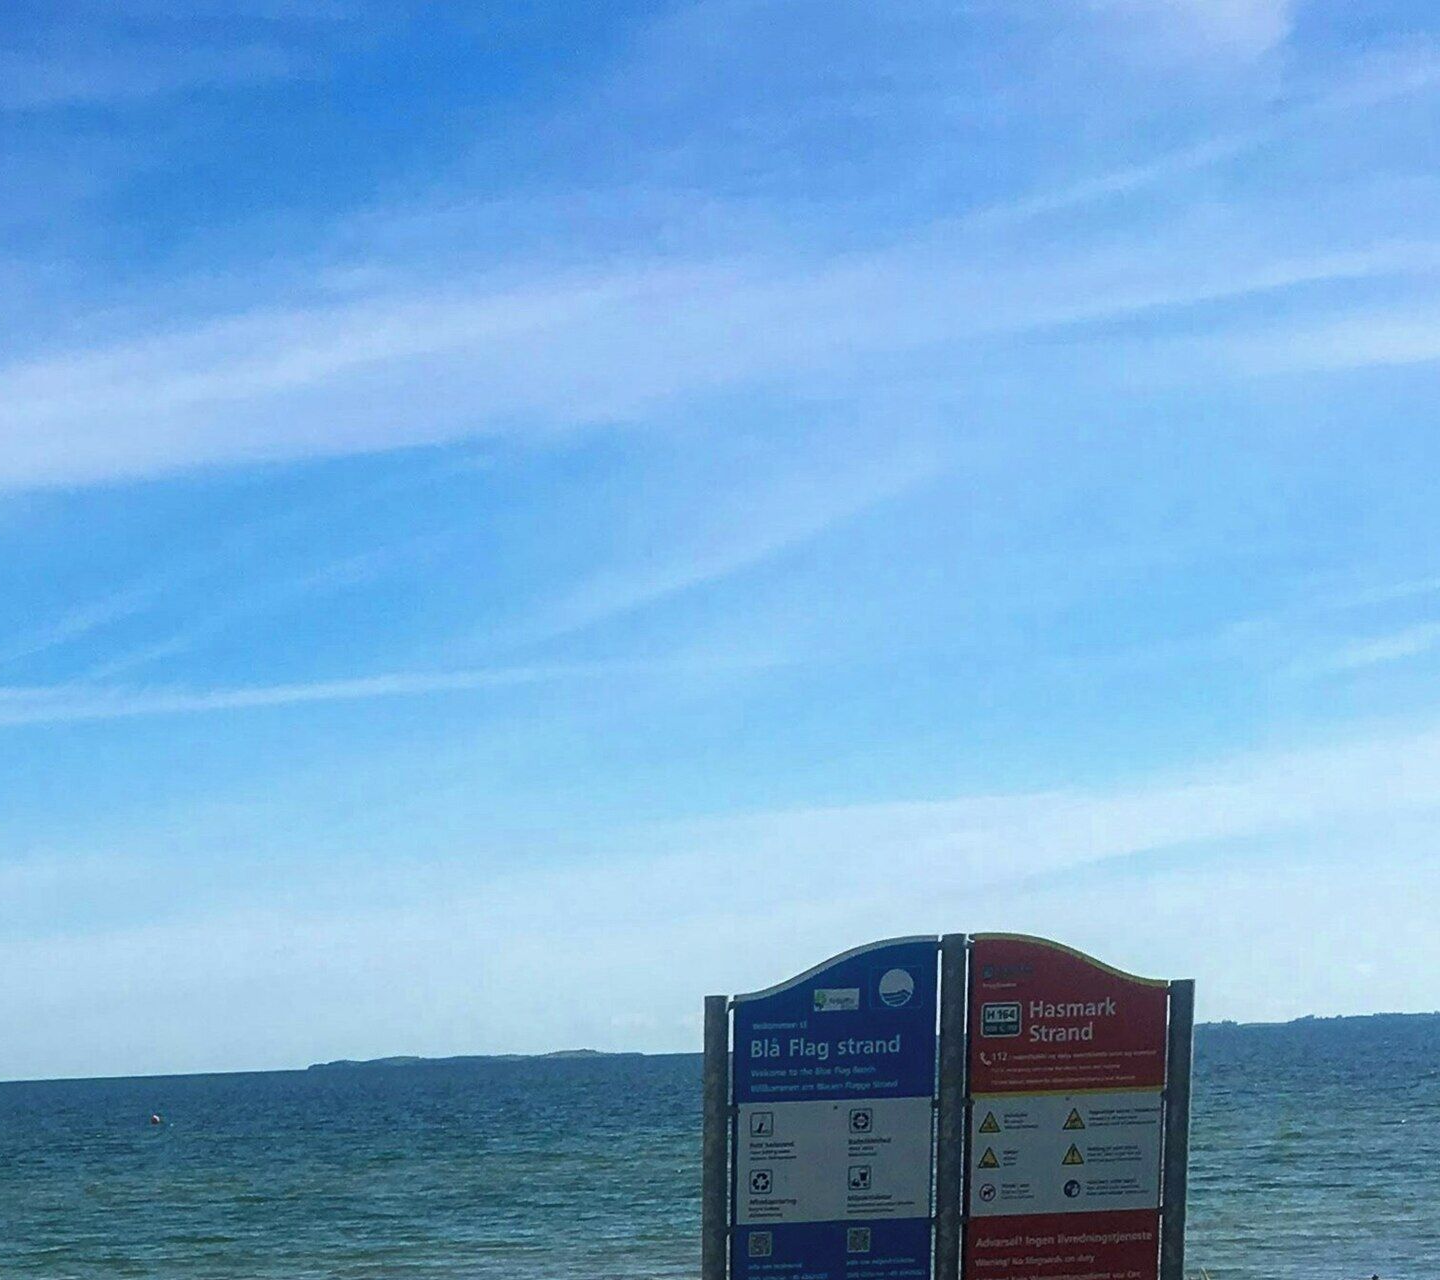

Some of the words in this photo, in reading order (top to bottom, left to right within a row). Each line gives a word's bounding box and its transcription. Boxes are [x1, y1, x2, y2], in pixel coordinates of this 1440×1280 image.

[987, 1008, 996, 1020] H
[1029, 997, 1116, 1019] Hasmark
[1029, 1021, 1093, 1043] Strand
[750, 1038, 781, 1058] Blå
[789, 1037, 829, 1060] Flag
[837, 1034, 901, 1055] strand
[992, 1051, 1008, 1062] 112
[975, 1237, 1023, 1248] Advarsel!
[1025, 1236, 1055, 1248] Ingen
